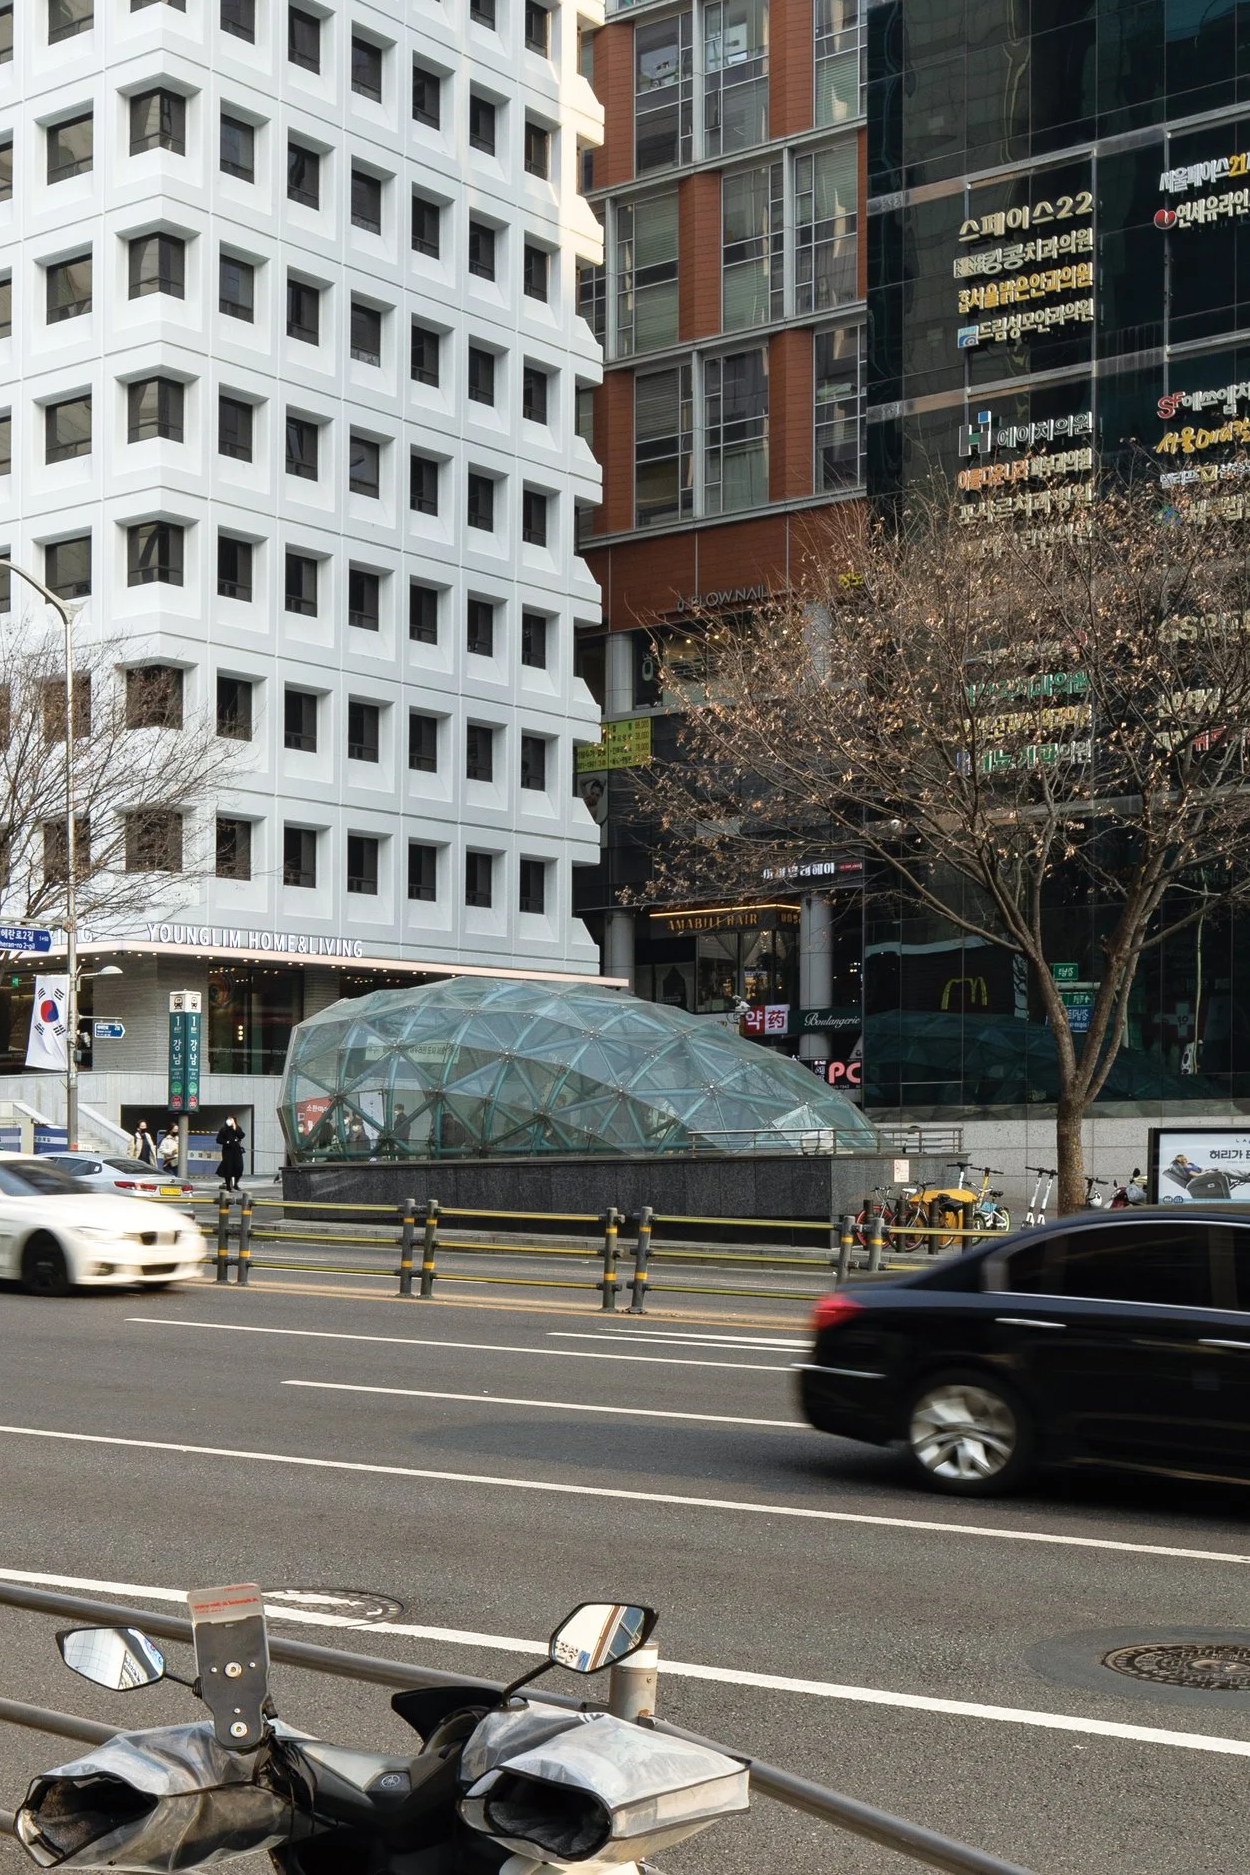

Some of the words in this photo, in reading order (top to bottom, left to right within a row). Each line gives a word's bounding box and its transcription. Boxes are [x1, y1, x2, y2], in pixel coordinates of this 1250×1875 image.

[1159, 152, 1250, 193] 서울페이스21
[997, 411, 1092, 447] 에이치의원
[727, 913, 758, 925] HAIR
[147, 923, 241, 948] YOUNGLIM
[249, 931, 363, 957] HOME&LIVING
[746, 1010, 763, 1030] 약
[768, 1010, 786, 1029] 药
[173, 1039, 182, 1065] 강남
[190, 1039, 198, 1065] 강남
[828, 1061, 861, 1084] PC
[1210, 1150, 1243, 1159] 허리가
